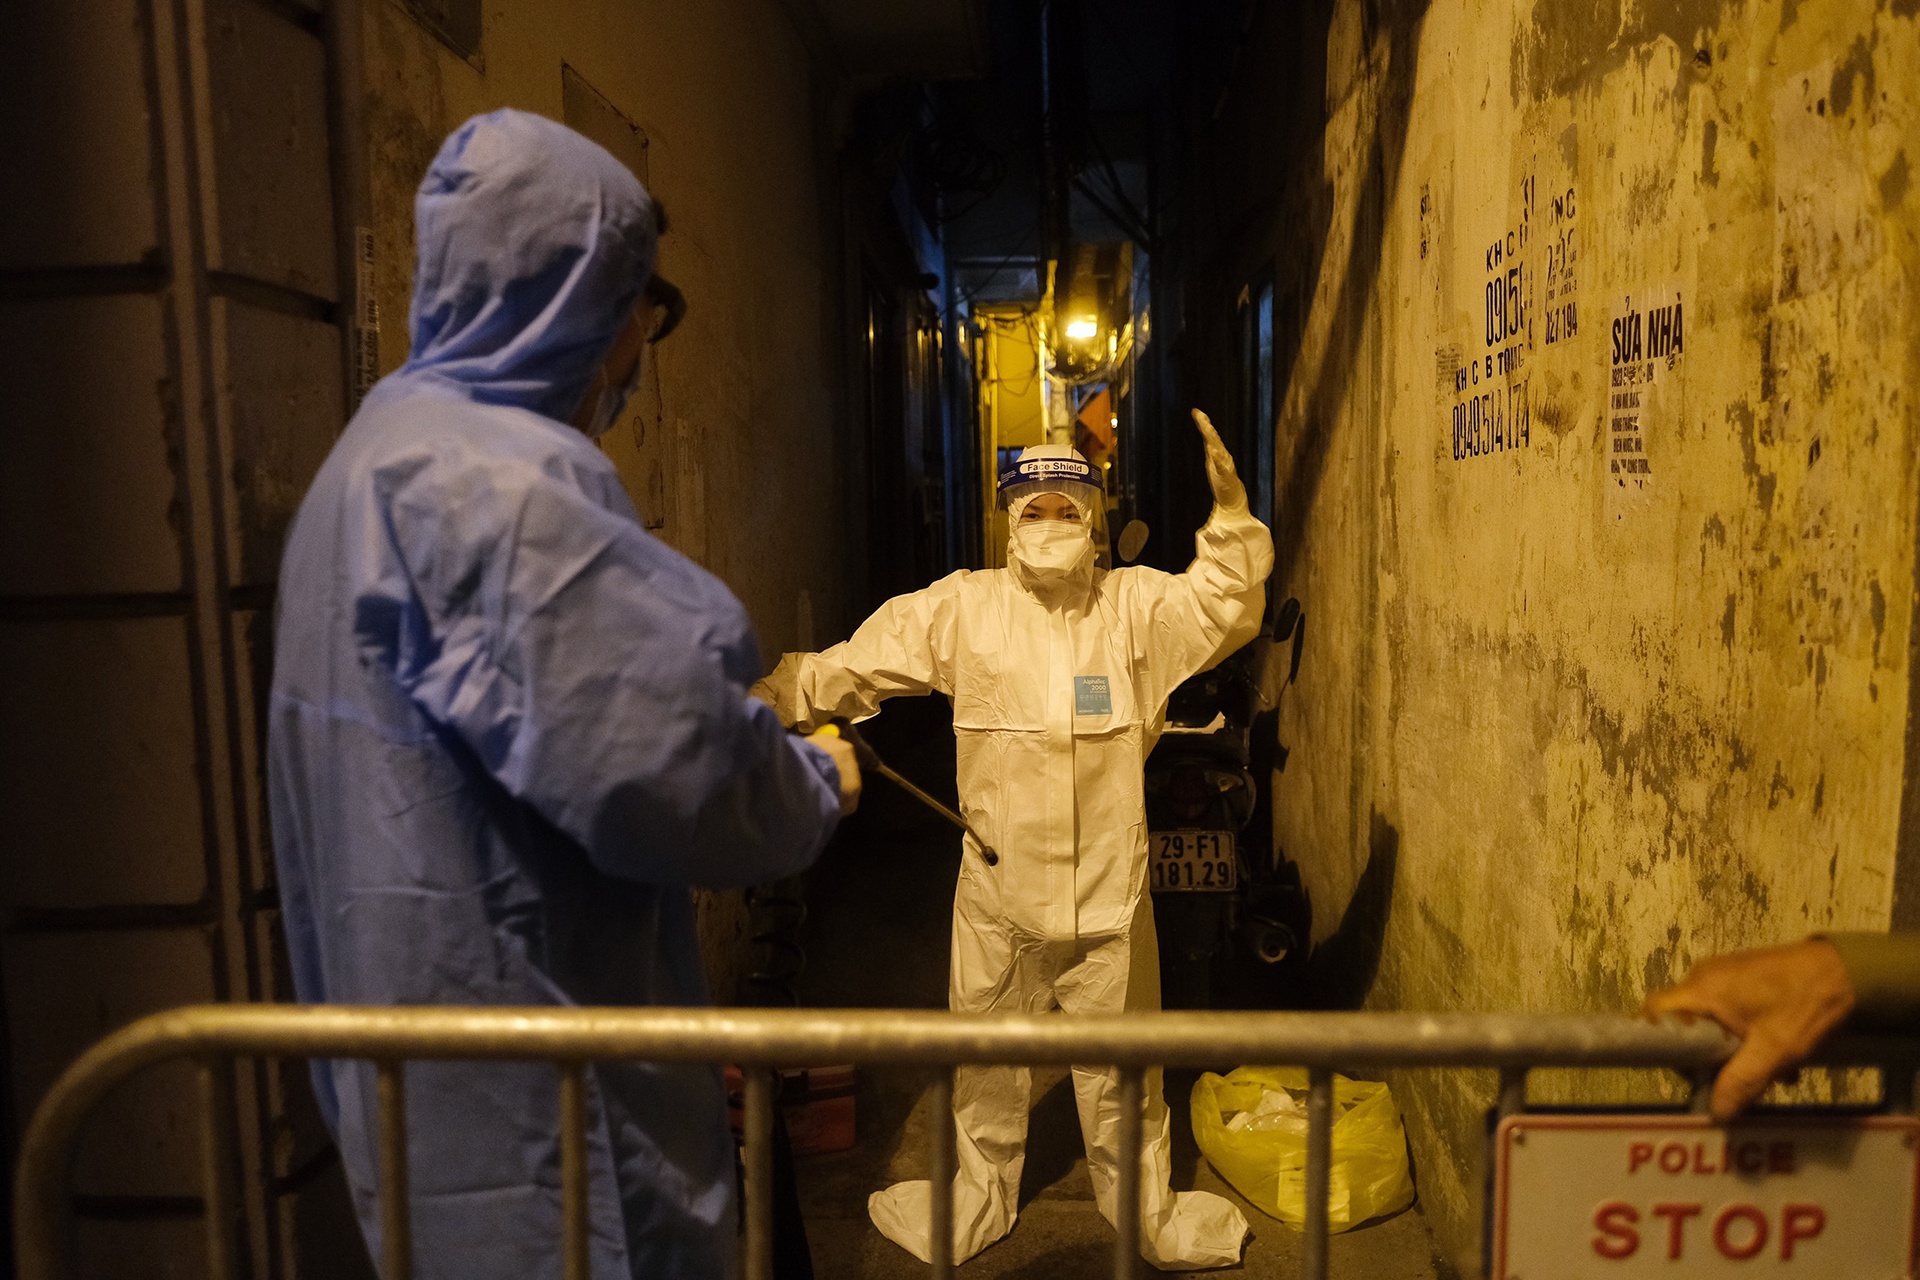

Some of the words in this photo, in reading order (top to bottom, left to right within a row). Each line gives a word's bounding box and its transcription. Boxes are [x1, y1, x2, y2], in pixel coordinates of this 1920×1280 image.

[1612, 296, 1642, 365] SỬA
[1647, 292, 1683, 359] NHÀ
[1027, 463, 1050, 472] Face
[1053, 462, 1082, 472] Shield
[1160, 835, 1219, 859] 29-F1
[1155, 861, 1229, 887] 181.29
[1627, 1141, 1795, 1175] POLICE
[1591, 1201, 1826, 1261] STOP
